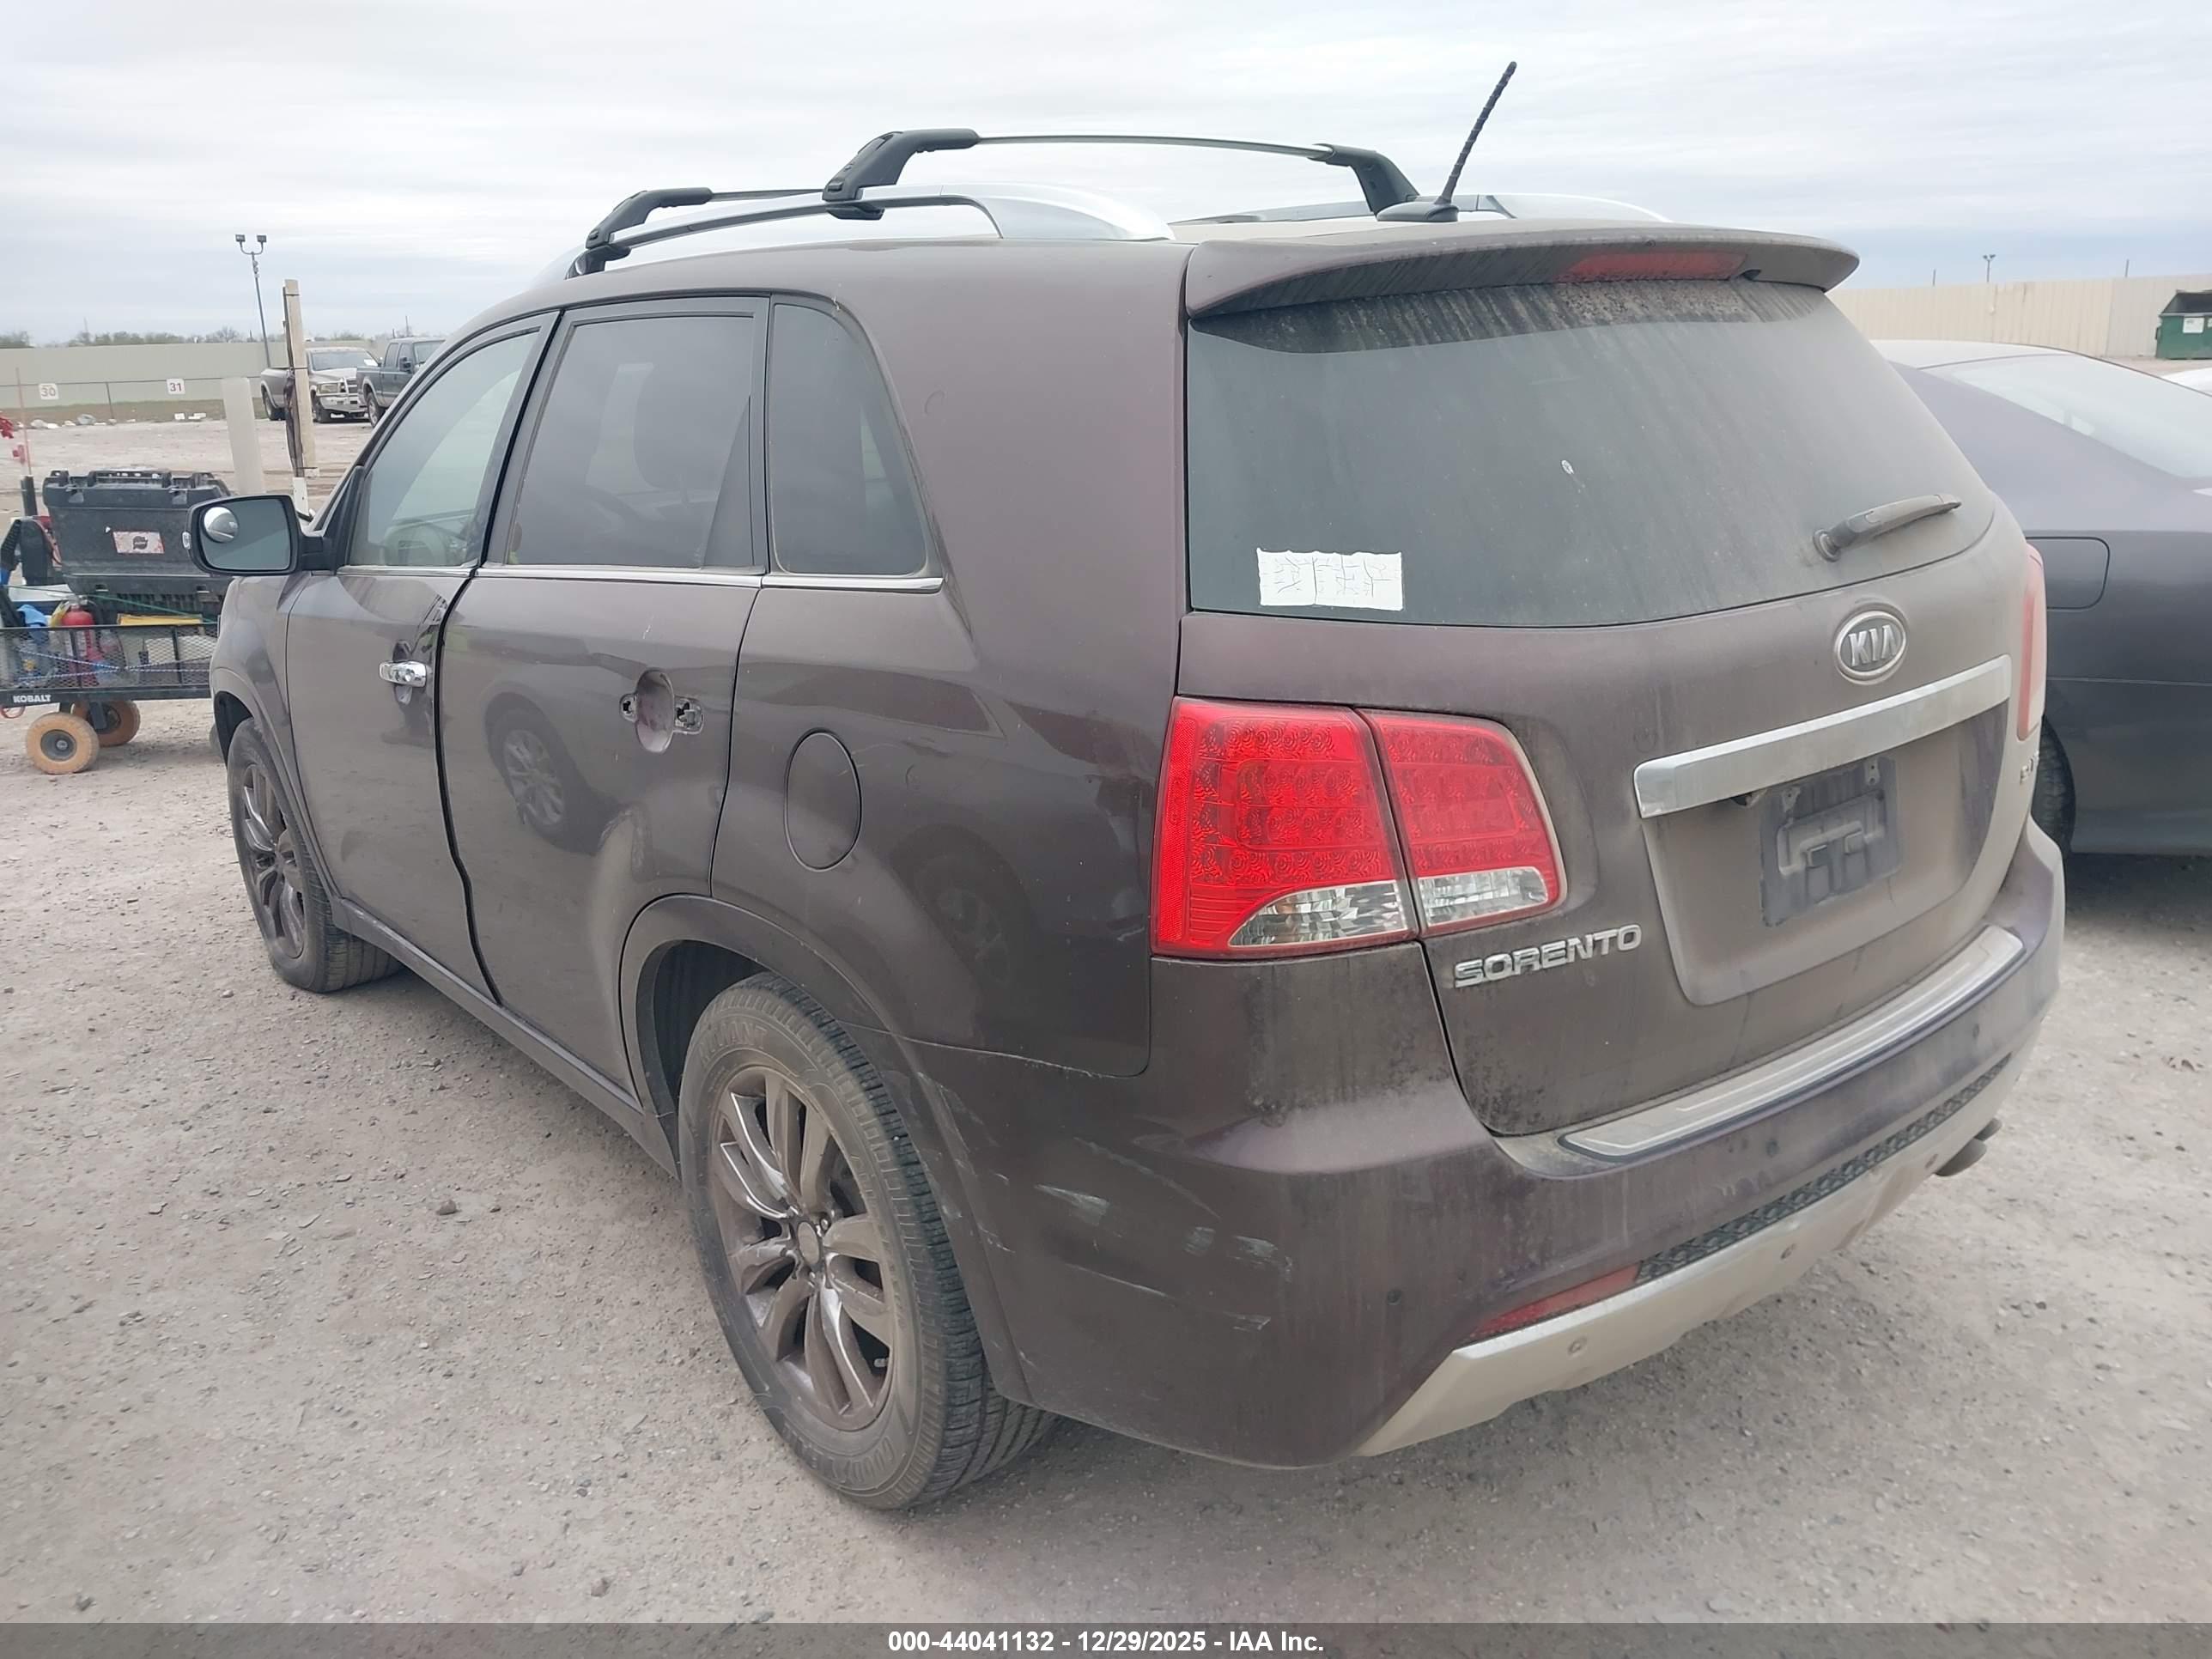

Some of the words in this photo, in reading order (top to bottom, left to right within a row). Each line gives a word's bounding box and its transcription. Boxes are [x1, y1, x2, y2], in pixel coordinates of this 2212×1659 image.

[40, 386, 57, 398] 30
[169, 382, 183, 392] 31
[1848, 624, 1897, 667] KIA
[13, 694, 52, 703] KOBALT
[1454, 924, 1643, 988] SORENTO
